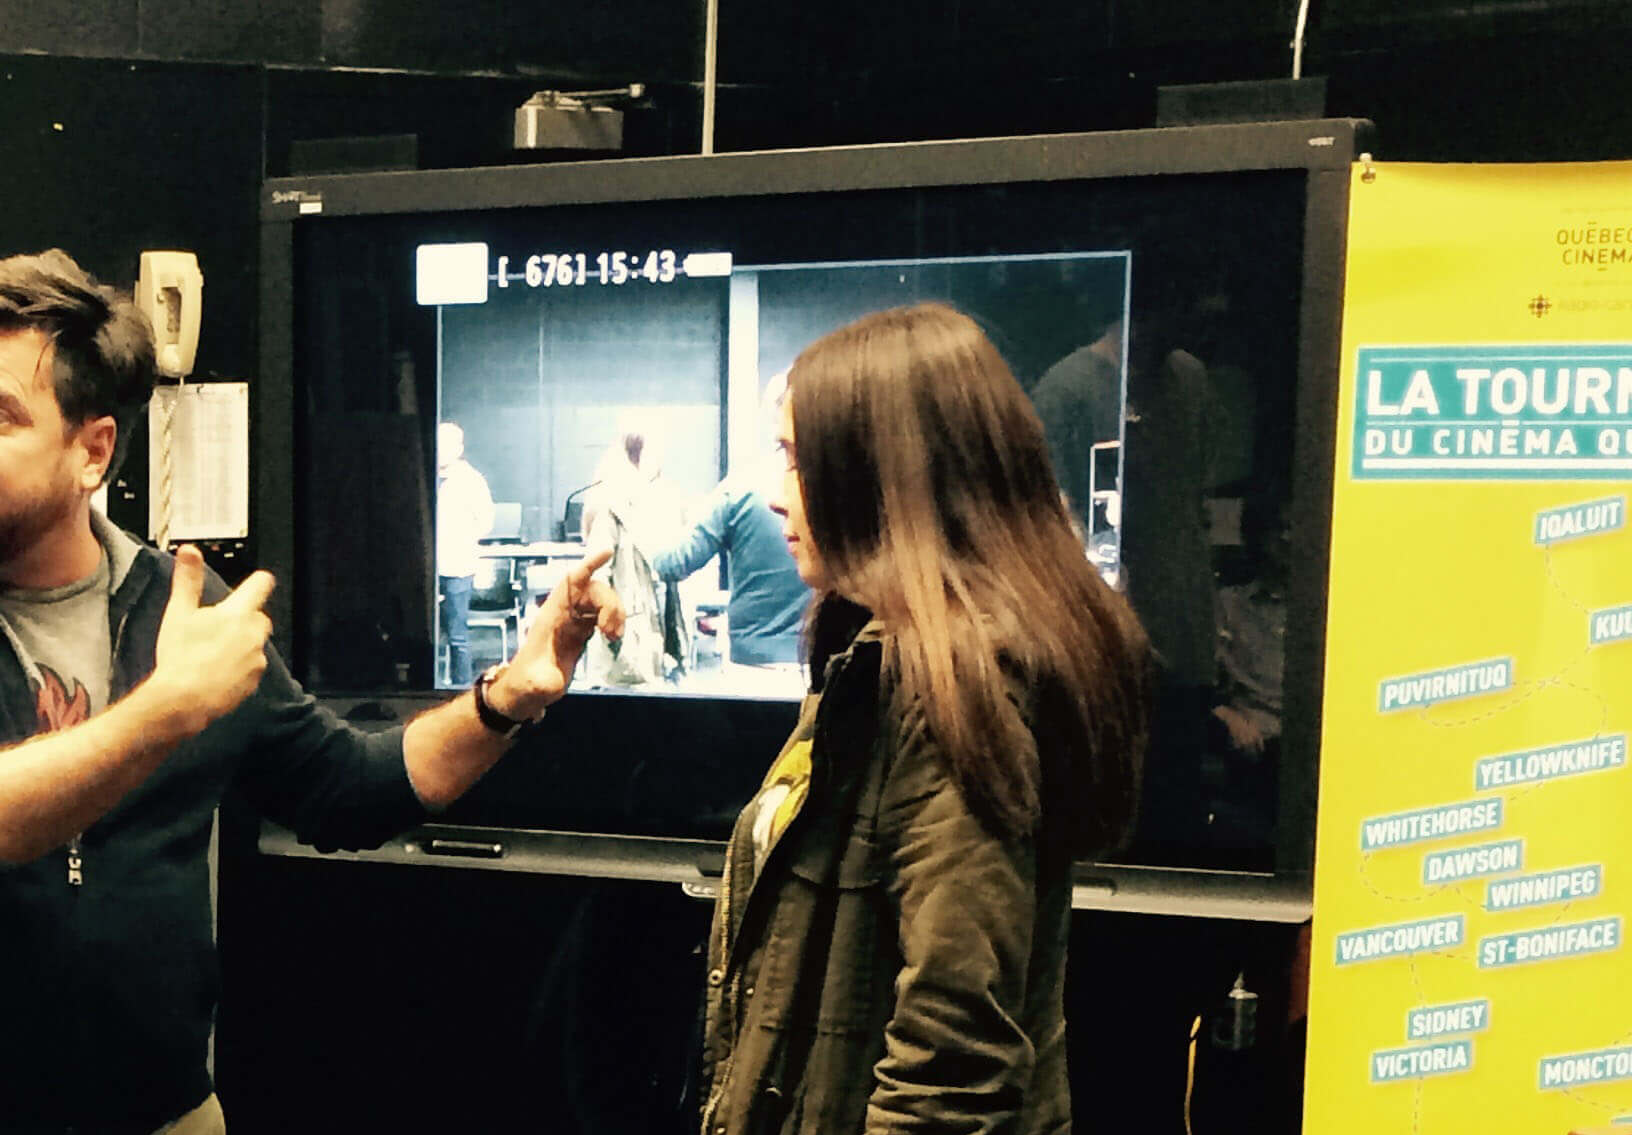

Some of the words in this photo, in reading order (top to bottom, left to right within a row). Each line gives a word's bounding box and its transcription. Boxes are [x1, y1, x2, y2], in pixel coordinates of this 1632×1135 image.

[597, 249, 676, 285] 15:43
[1366, 369, 1441, 416] LA
[1365, 429, 1414, 456] DU
[1538, 498, 1622, 541] IQALUIT
[1383, 660, 1508, 709] PUVIRNITUQ
[1479, 738, 1624, 787] YELLOWKNIFE
[1366, 801, 1500, 848] WHITEHORSE
[1427, 844, 1519, 882] DAWSON
[1490, 868, 1599, 908] WINNIPEG
[1339, 920, 1460, 961] VANCOUVER
[1482, 922, 1616, 964] ST-BONIFACE
[1411, 1003, 1485, 1038] SIDNEY
[1375, 1042, 1468, 1078] VICTORIA
[1543, 1052, 1632, 1086] MONCTO
